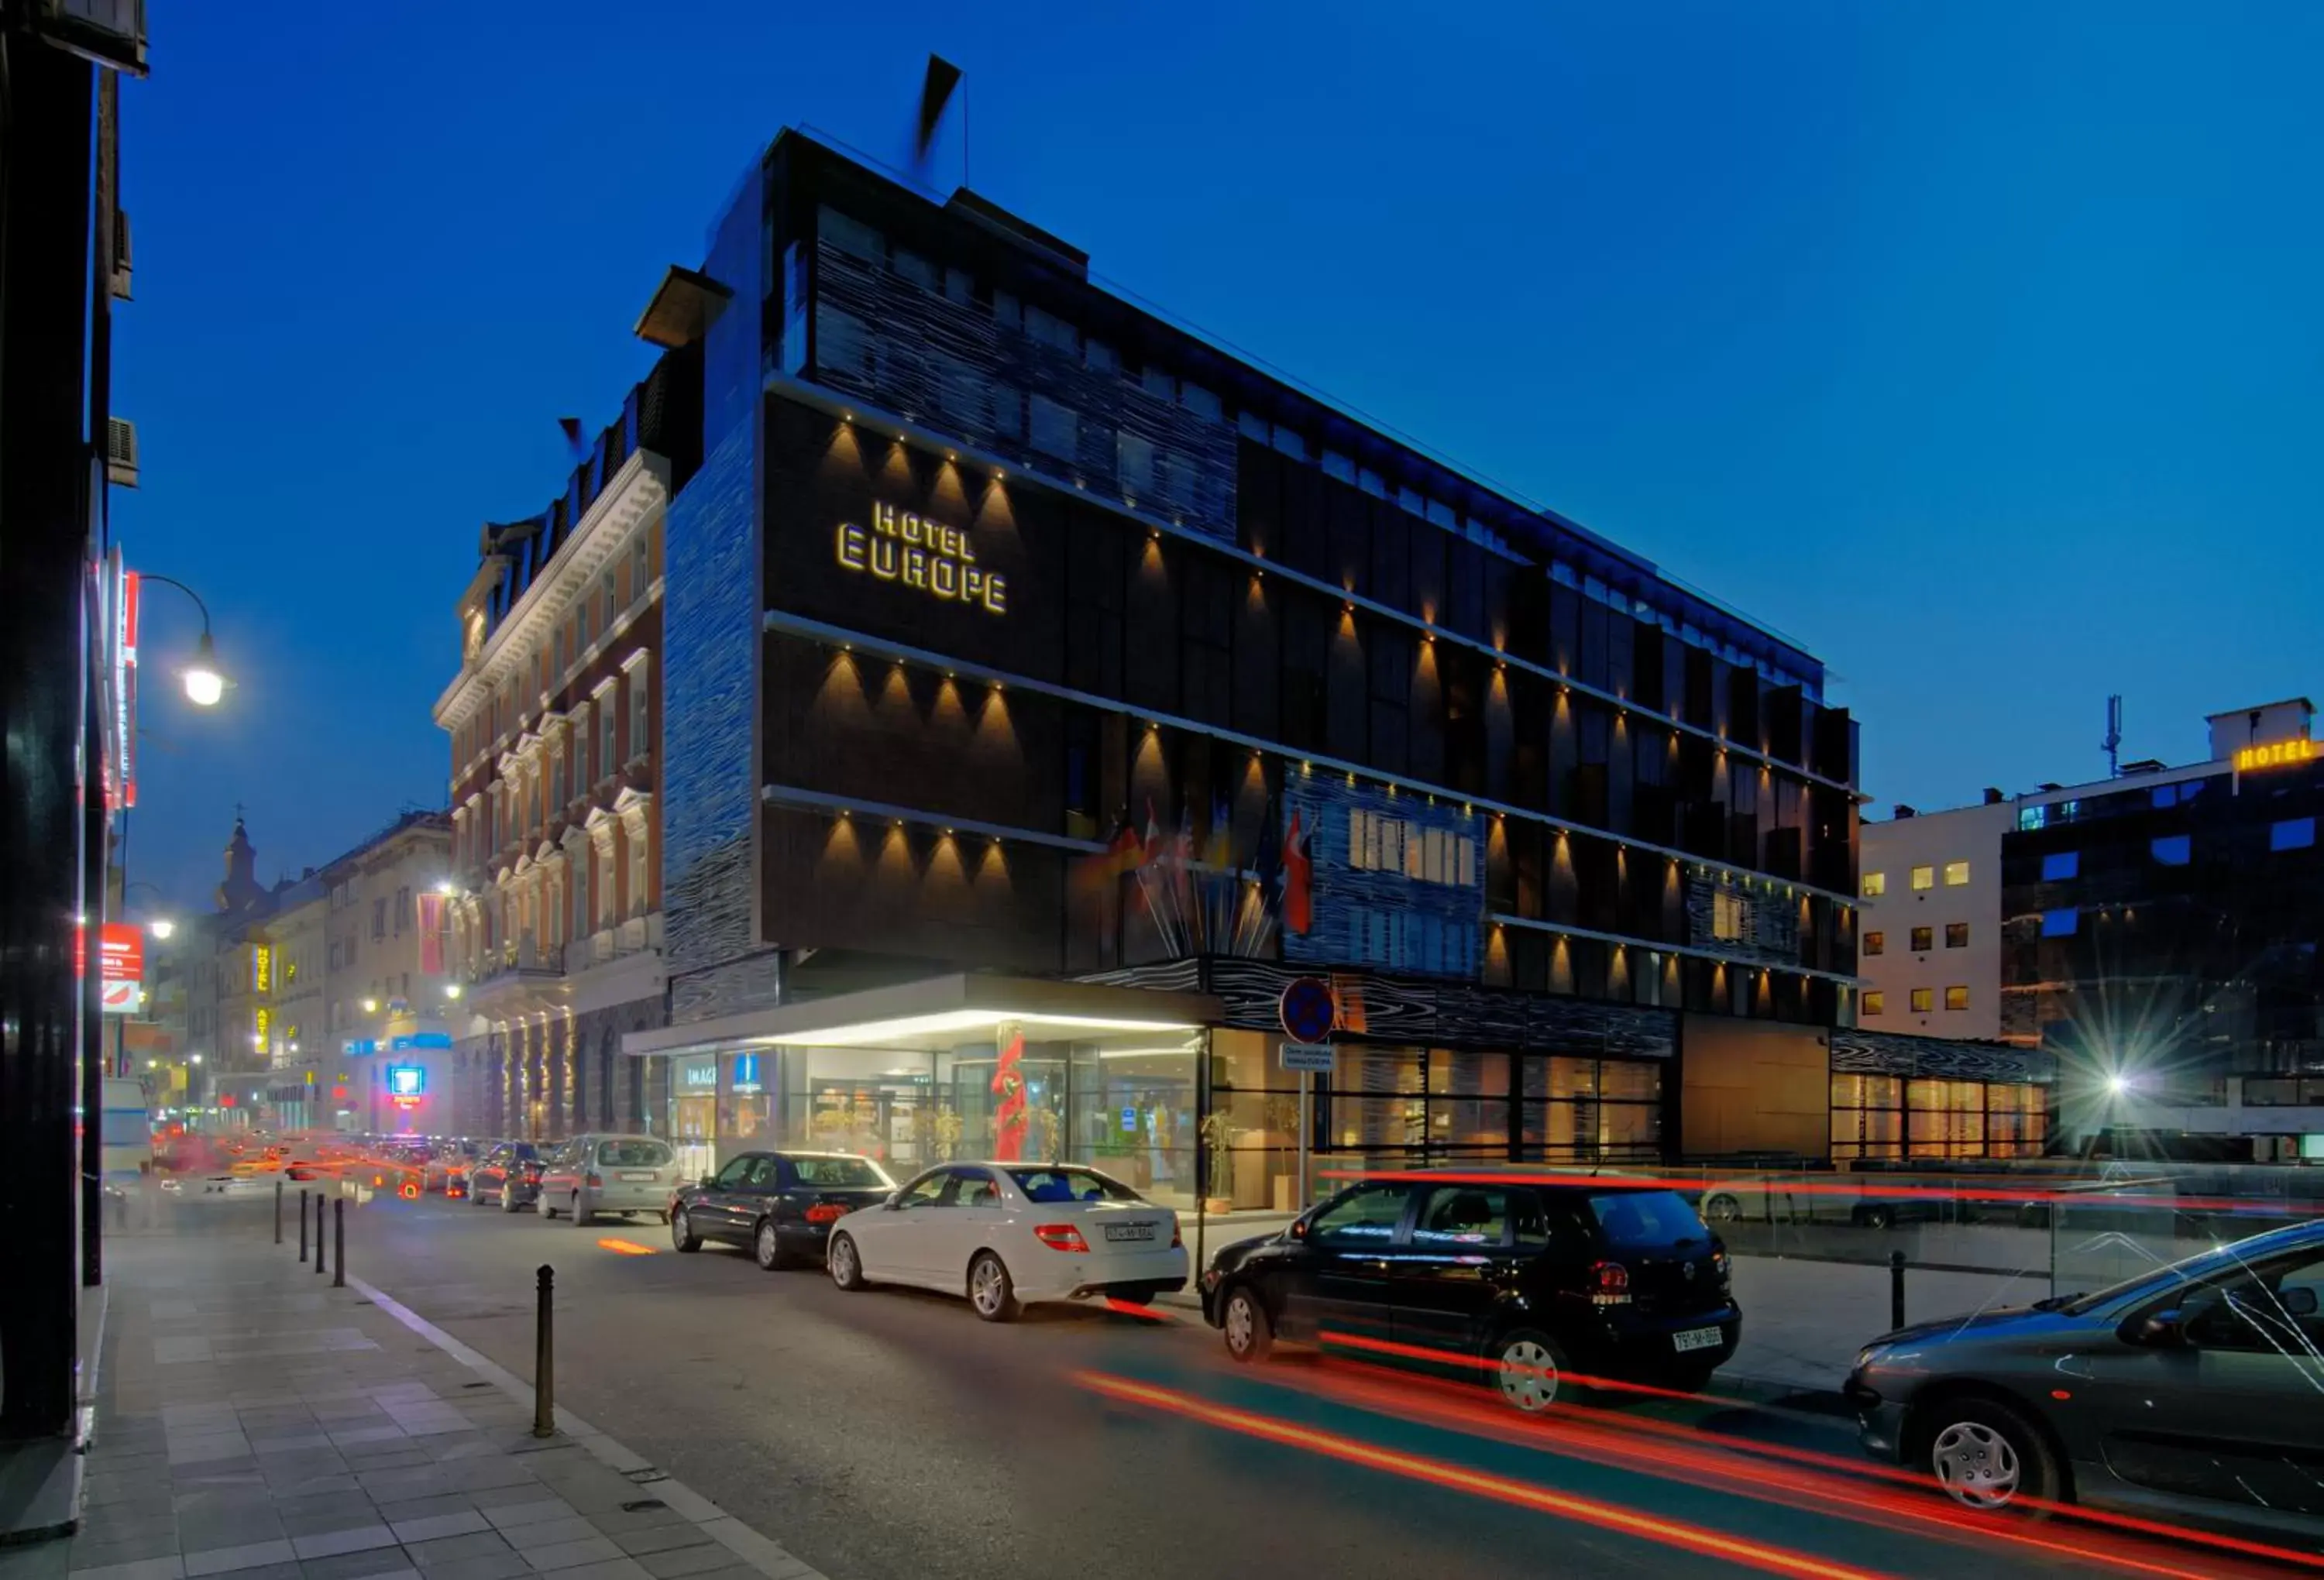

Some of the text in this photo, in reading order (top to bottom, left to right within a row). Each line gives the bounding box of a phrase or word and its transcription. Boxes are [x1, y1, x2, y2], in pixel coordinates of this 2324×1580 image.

[873, 501, 975, 562] HOTEL
[837, 523, 1006, 613] EUROPE
[2240, 739, 2312, 769] HOTEL
